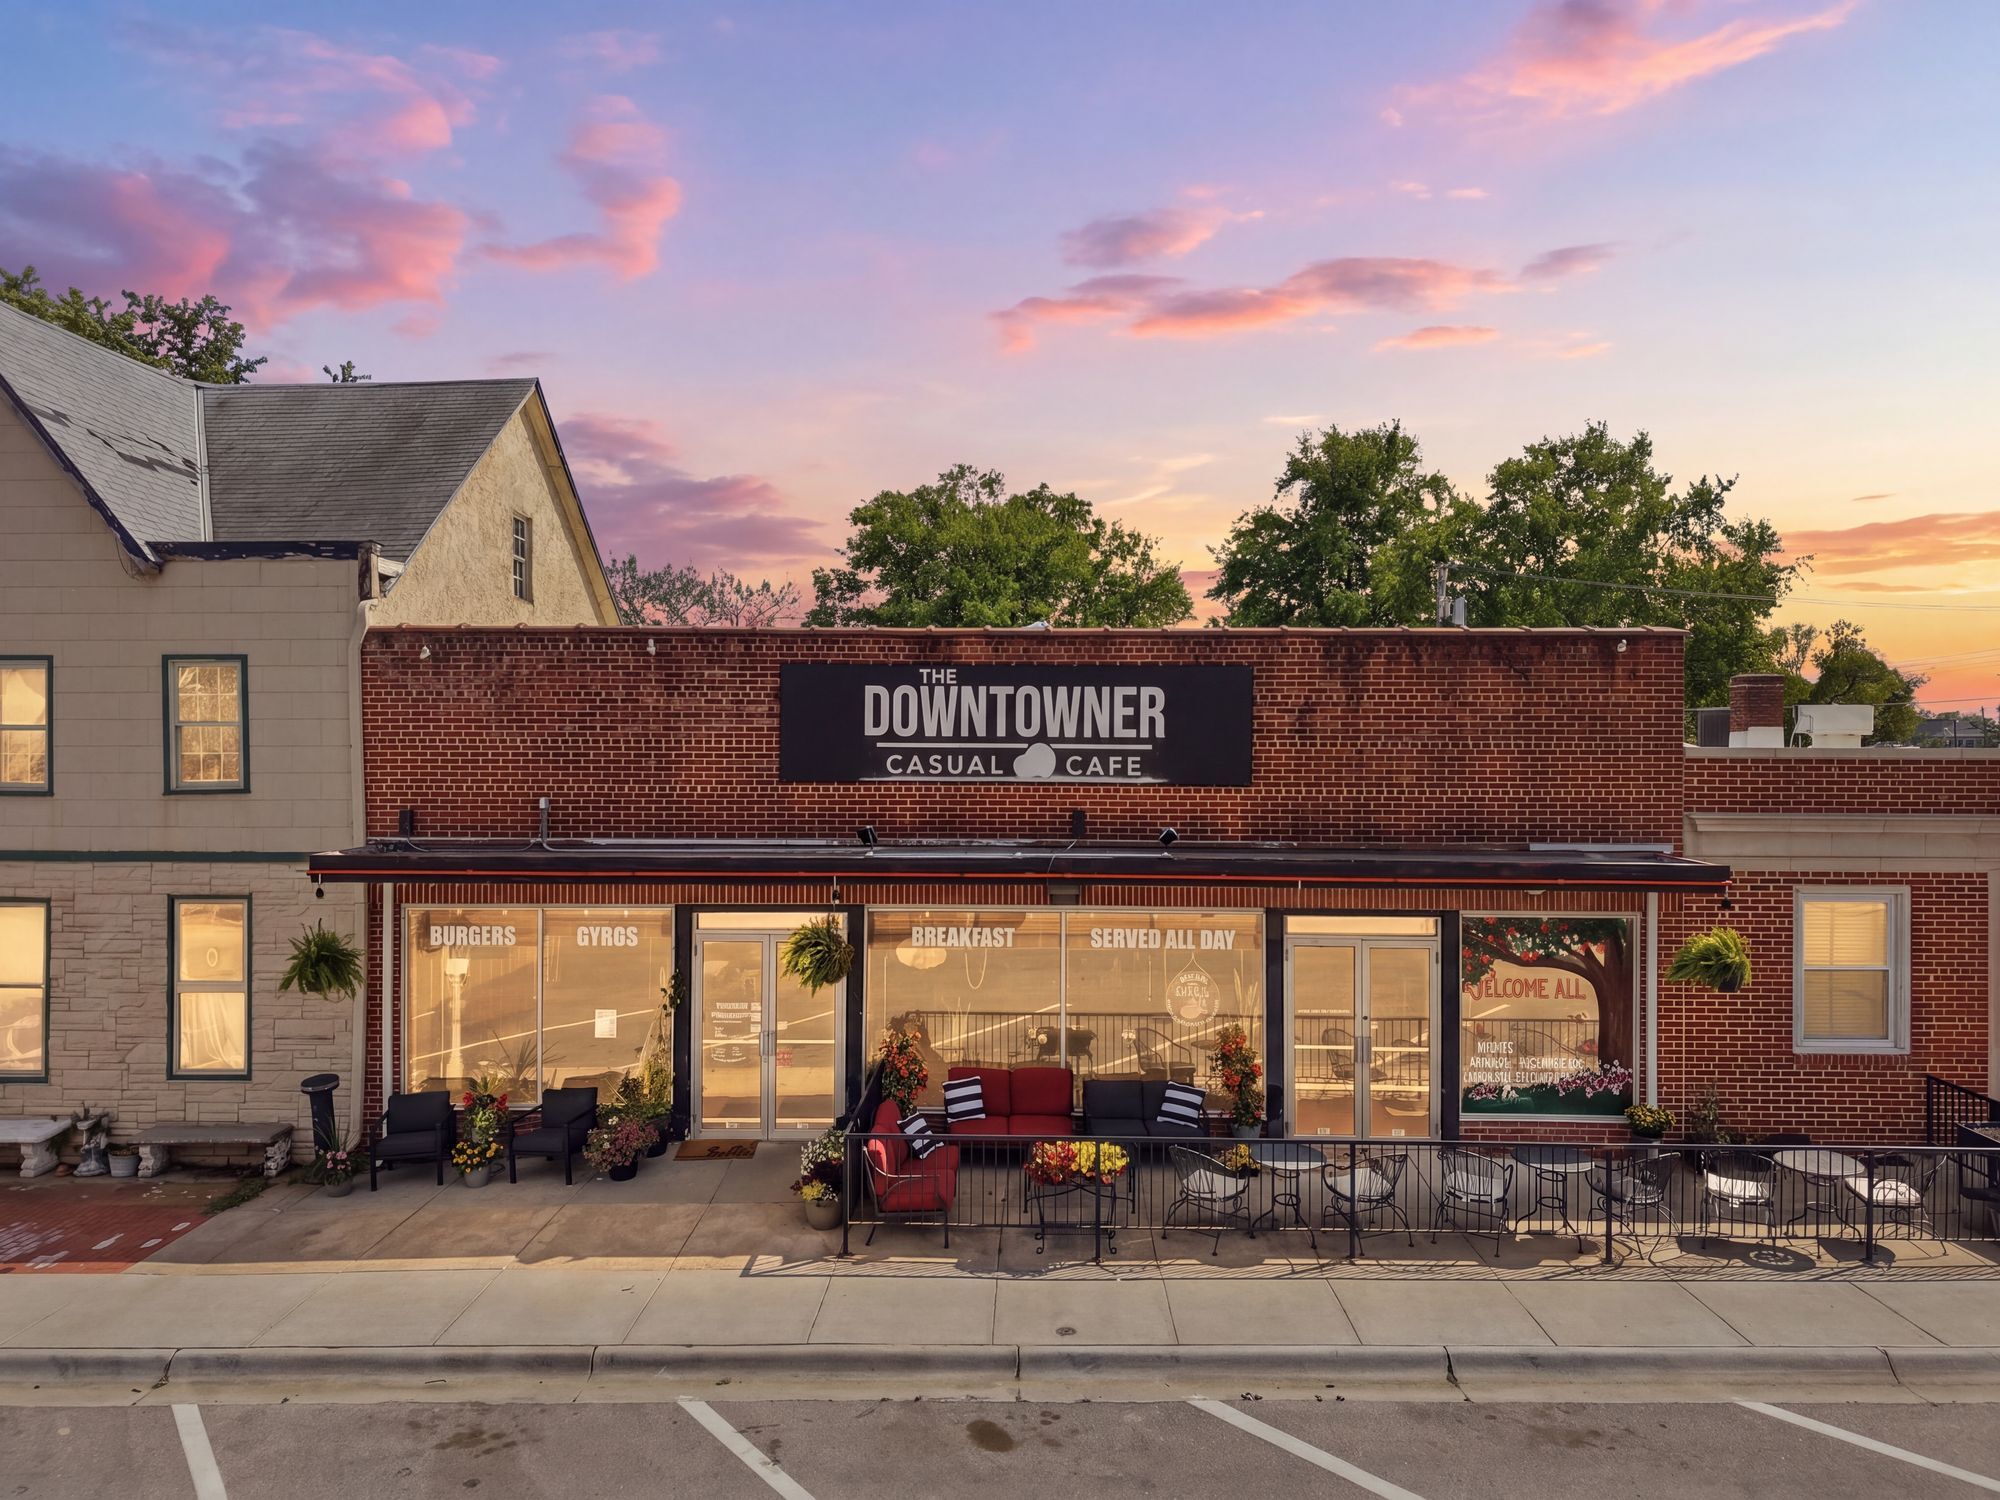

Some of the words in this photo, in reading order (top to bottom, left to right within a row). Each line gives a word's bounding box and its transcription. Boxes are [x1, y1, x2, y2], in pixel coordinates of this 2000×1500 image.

[919, 668, 957, 684] THE
[864, 685, 1166, 738] DOWNTOWNER
[886, 754, 1003, 775] CASUAL
[1065, 756, 1142, 776] CAFE
[430, 925, 516, 946] BURGERS
[911, 926, 1016, 948] BREAKFAST
[1090, 928, 1161, 949] SERVED
[1164, 929, 1196, 950] ALL
[1200, 930, 1236, 950] DAY
[1554, 977, 1587, 999] ALL
